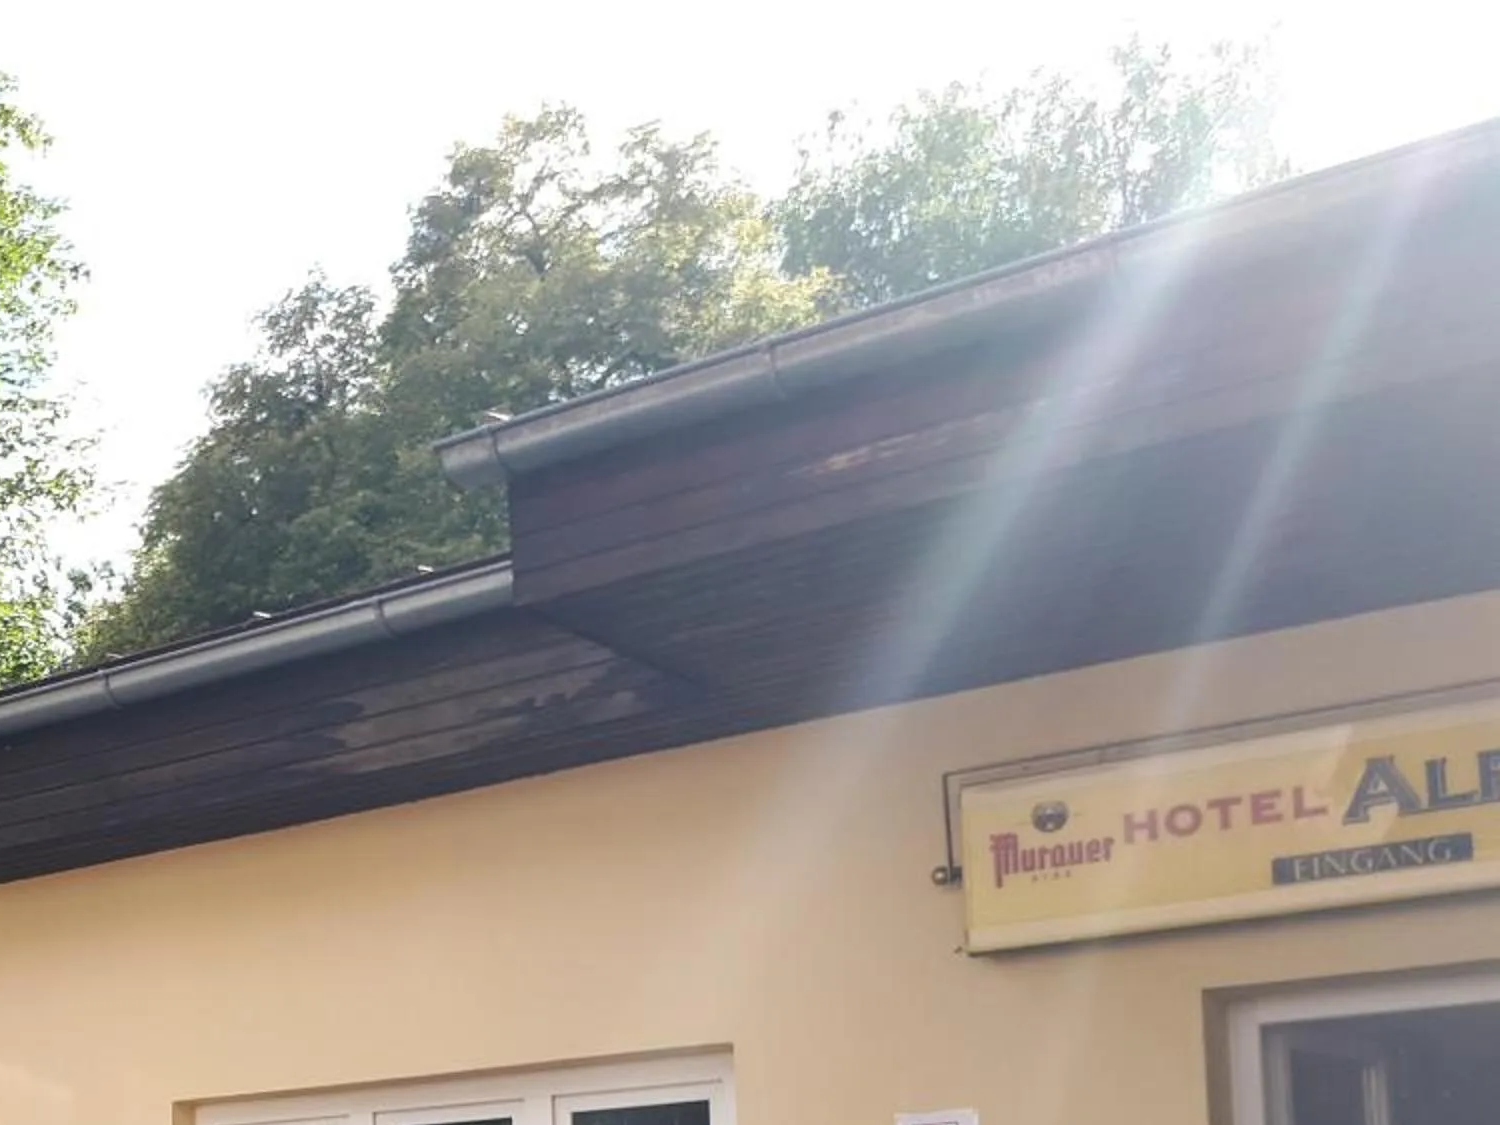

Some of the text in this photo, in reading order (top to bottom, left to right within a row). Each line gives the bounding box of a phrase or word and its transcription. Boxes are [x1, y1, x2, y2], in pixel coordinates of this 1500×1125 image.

[1123, 785, 1329, 845] HOTEL
[990, 832, 1115, 889] Murauer
[1292, 838, 1453, 881] EINGANG
